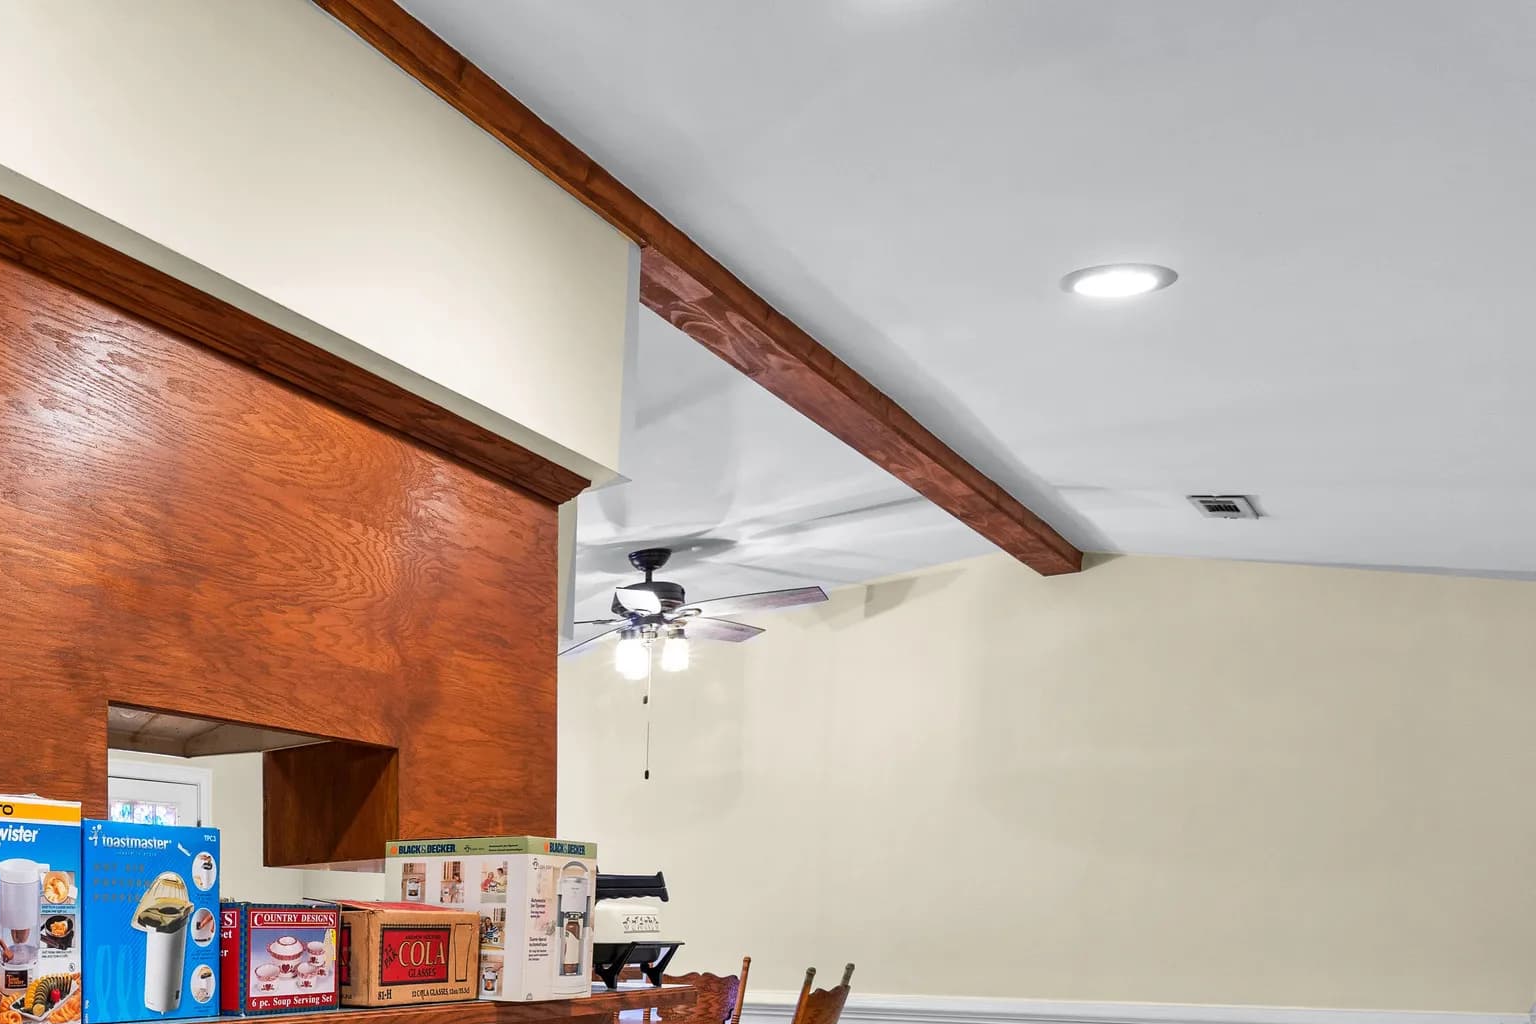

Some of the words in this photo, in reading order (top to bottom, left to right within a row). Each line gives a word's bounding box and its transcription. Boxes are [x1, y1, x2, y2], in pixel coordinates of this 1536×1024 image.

[102, 833, 168, 849] toastmaster
[204, 834, 216, 842] TPC3
[398, 843, 456, 855] BLACK&DECKER
[254, 913, 298, 926] COUNTRY
[301, 913, 336, 926] DESIGNS
[398, 940, 447, 967] COLA
[408, 968, 437, 978] GLASSES
[251, 999, 256, 1007] 6
[259, 999, 271, 1008] pc.
[273, 997, 291, 1007] Soup
[293, 995, 320, 1005] Serving
[321, 994, 333, 1002] Set
